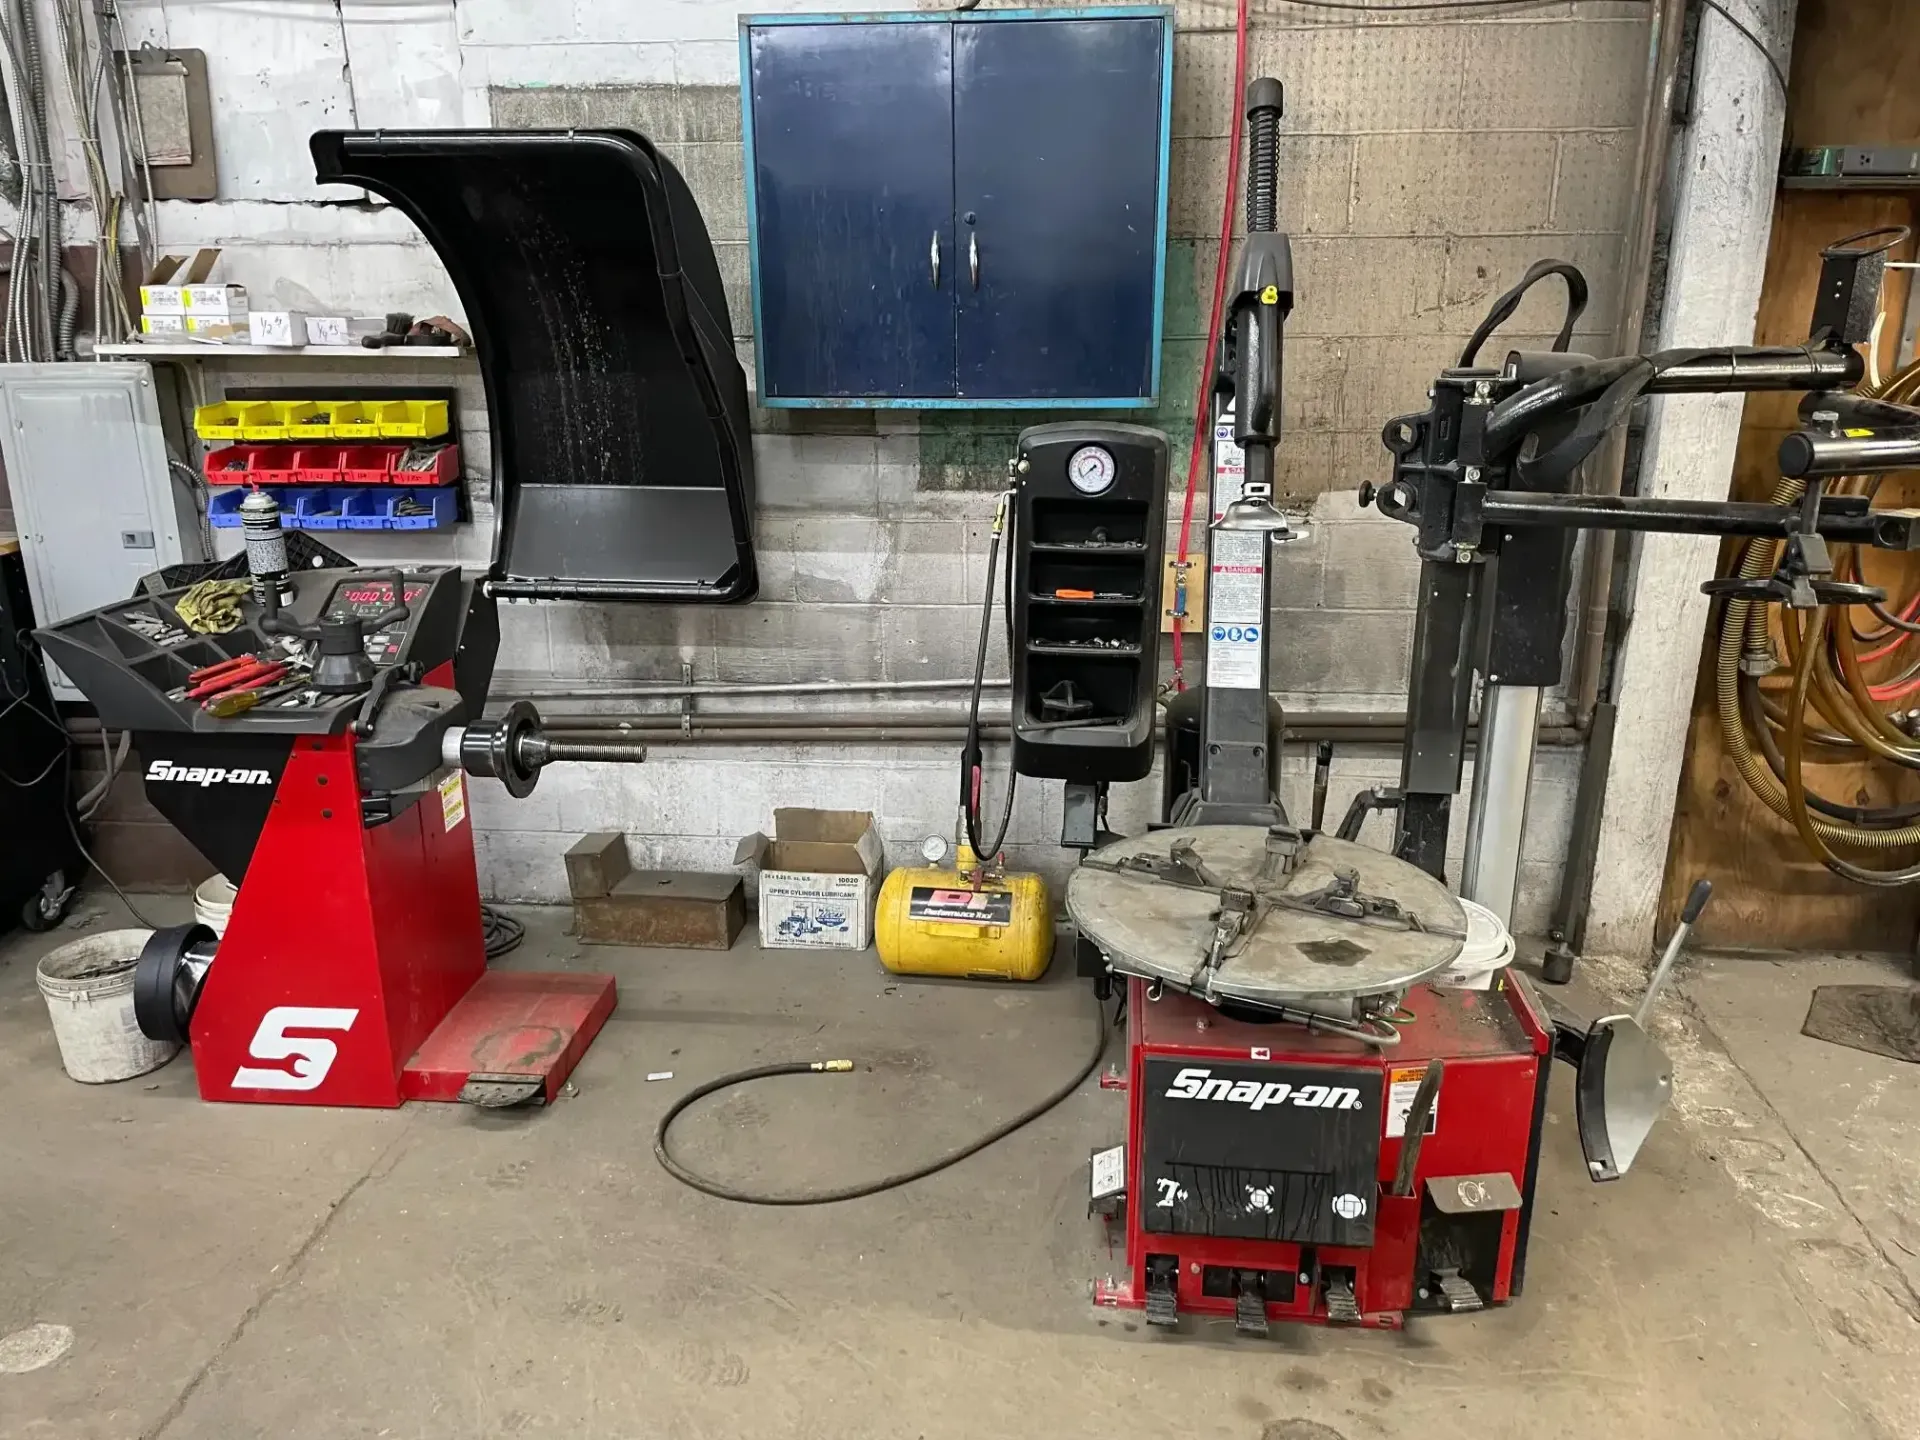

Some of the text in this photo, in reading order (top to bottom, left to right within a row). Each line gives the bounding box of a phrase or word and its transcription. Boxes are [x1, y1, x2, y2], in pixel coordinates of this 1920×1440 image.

[145, 760, 270, 787] Snap-on
[790, 889, 821, 897] CYLINDER
[821, 890, 856, 898] LUBRICANT
[923, 908, 993, 919] Performance Tool
